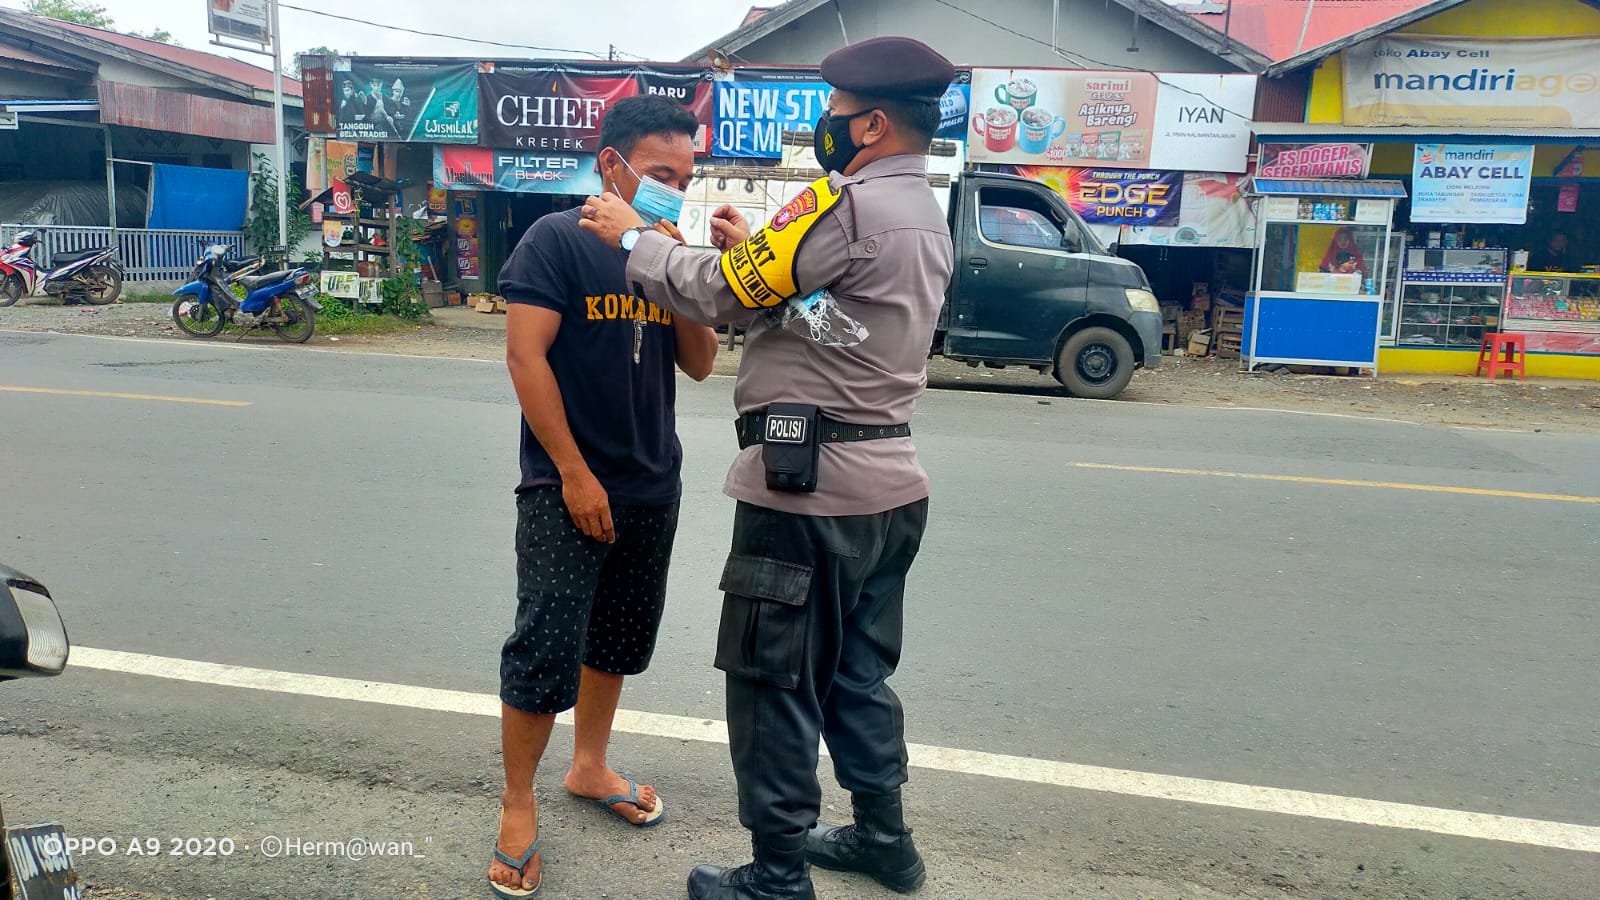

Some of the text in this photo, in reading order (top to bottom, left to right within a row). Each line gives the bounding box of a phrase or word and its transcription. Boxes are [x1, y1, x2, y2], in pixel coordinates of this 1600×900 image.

[1406, 49, 1450, 59] Abay
[1456, 49, 1490, 58] Cell
[648, 85, 686, 98] BARU
[1086, 80, 1129, 91] sarimi
[719, 87, 779, 119] NEW
[1079, 103, 1131, 117] Asiknya
[496, 94, 605, 129] CHIEF
[1178, 106, 1224, 124] IYAN
[1086, 112, 1137, 127] Bareng!
[516, 136, 583, 150] KRETEK
[719, 121, 748, 152] OF
[1278, 145, 1350, 166] ES DOGER
[1445, 149, 1495, 160] mandiri
[498, 156, 578, 169] FILTER
[1311, 158, 1361, 176] MANIS
[515, 170, 563, 181] BLACK
[1420, 166, 1524, 179] ABAY CELL
[1079, 181, 1171, 206] EDGE
[1096, 206, 1143, 217] PUNCH
[769, 419, 802, 439] POLISI
